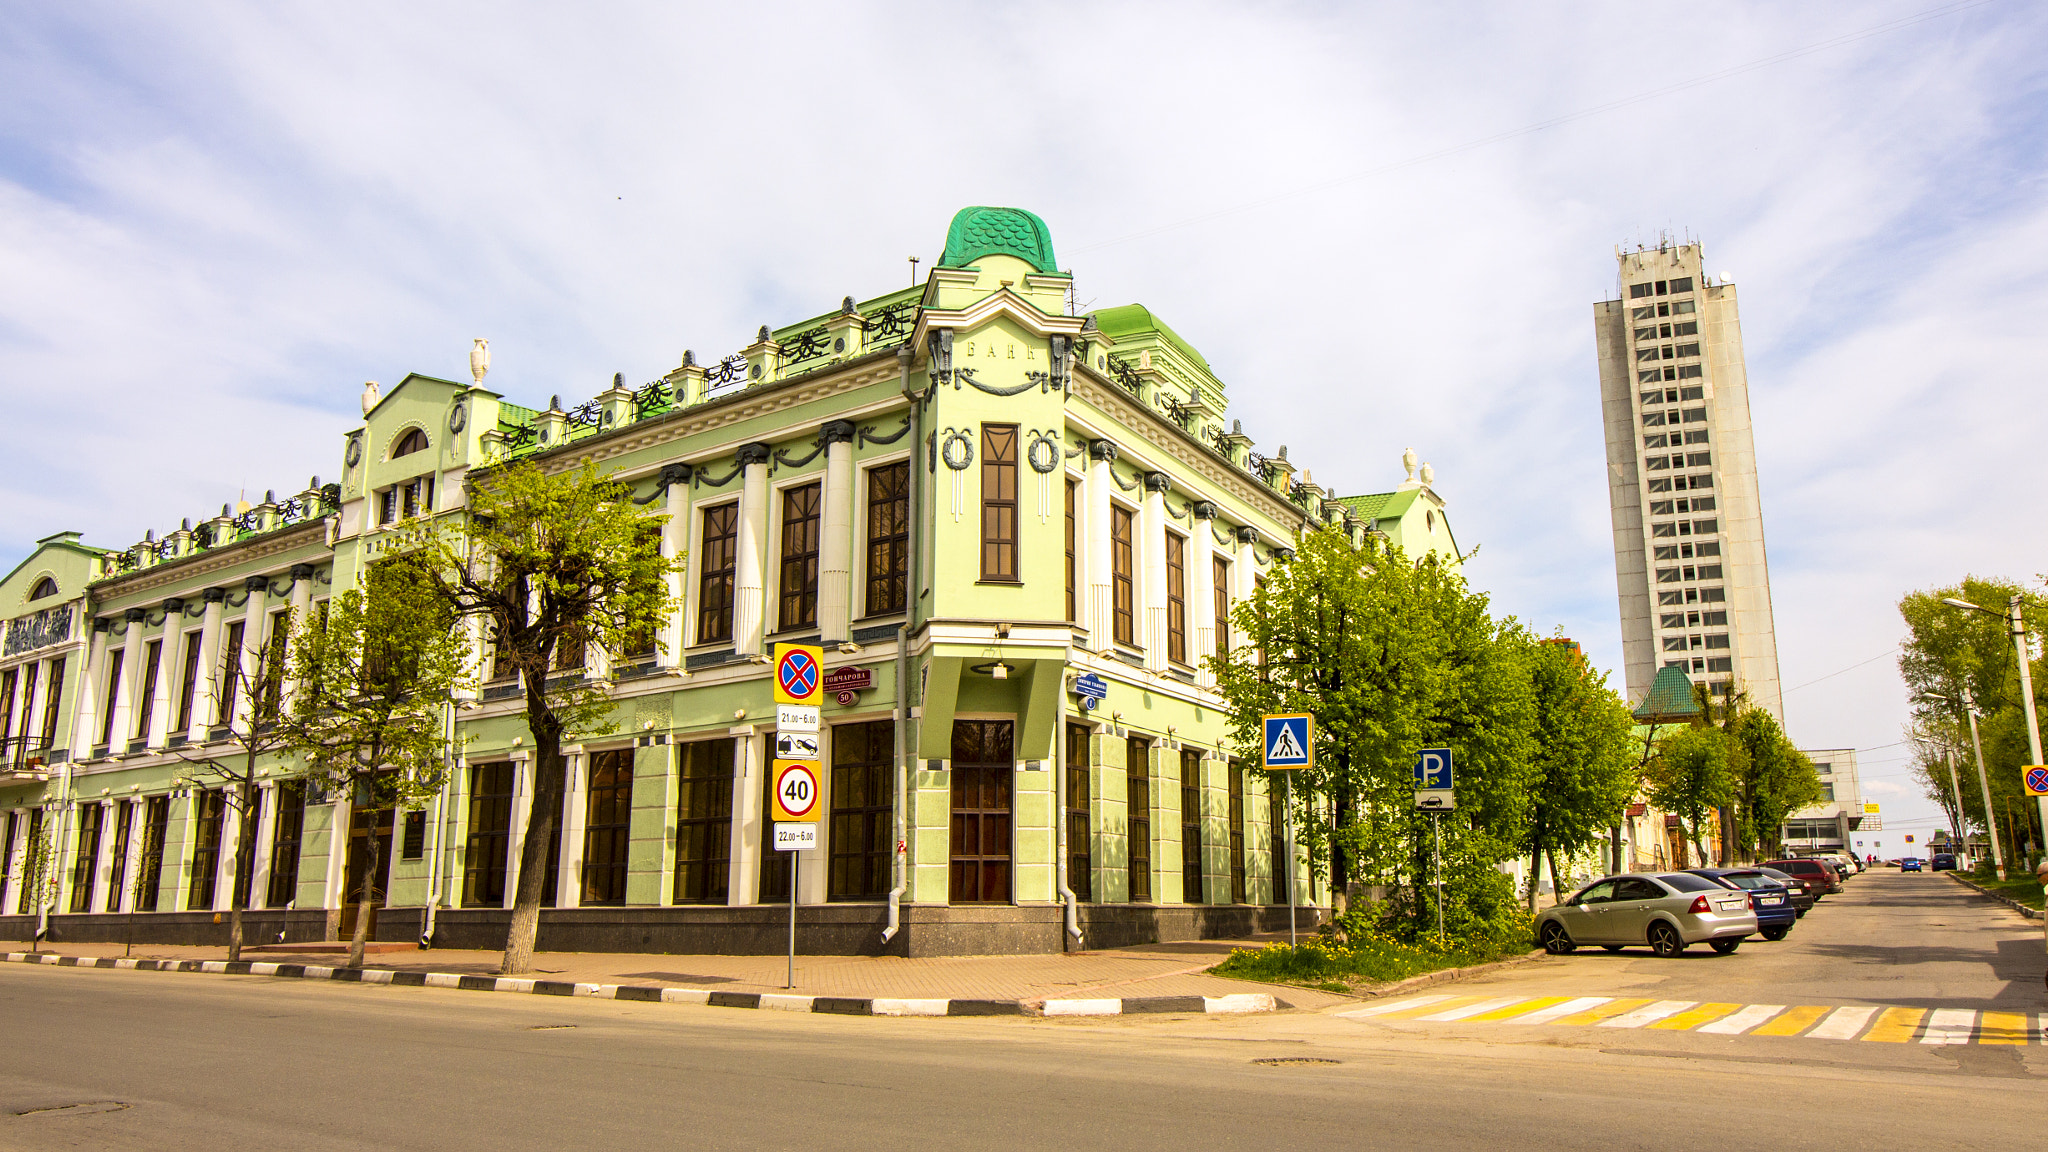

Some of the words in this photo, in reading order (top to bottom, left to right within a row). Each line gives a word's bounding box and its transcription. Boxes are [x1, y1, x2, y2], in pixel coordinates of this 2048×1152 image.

[967, 342, 1035, 360] БАНК
[825, 672, 866, 684] ГОНЧАРОВА
[840, 693, 849, 702] 50
[785, 780, 808, 800] 40
